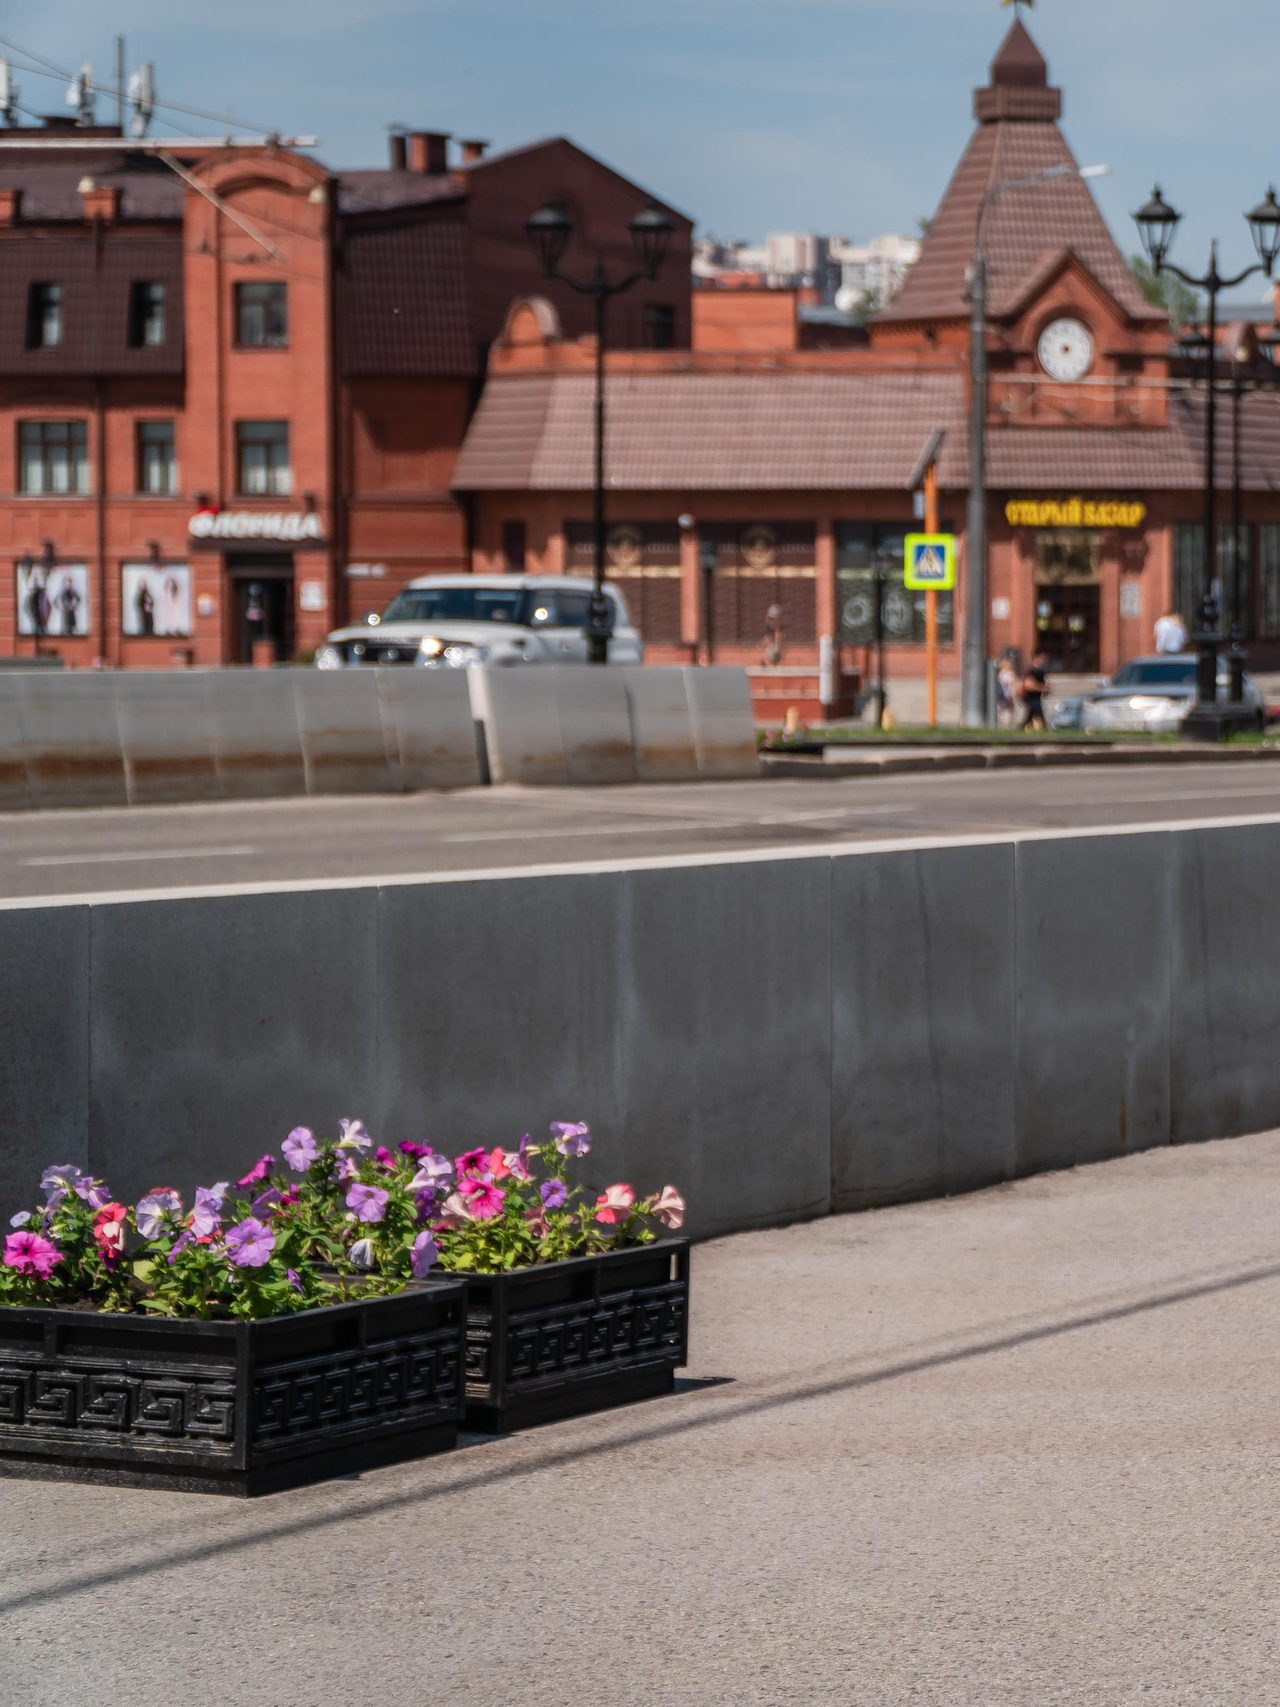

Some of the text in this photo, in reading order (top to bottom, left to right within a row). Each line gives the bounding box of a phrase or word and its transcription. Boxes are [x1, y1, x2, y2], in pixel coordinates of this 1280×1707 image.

[188, 510, 325, 540] ФЛОРИДА
[1005, 496, 1146, 527] СТАРЫЙ БАЗАР
